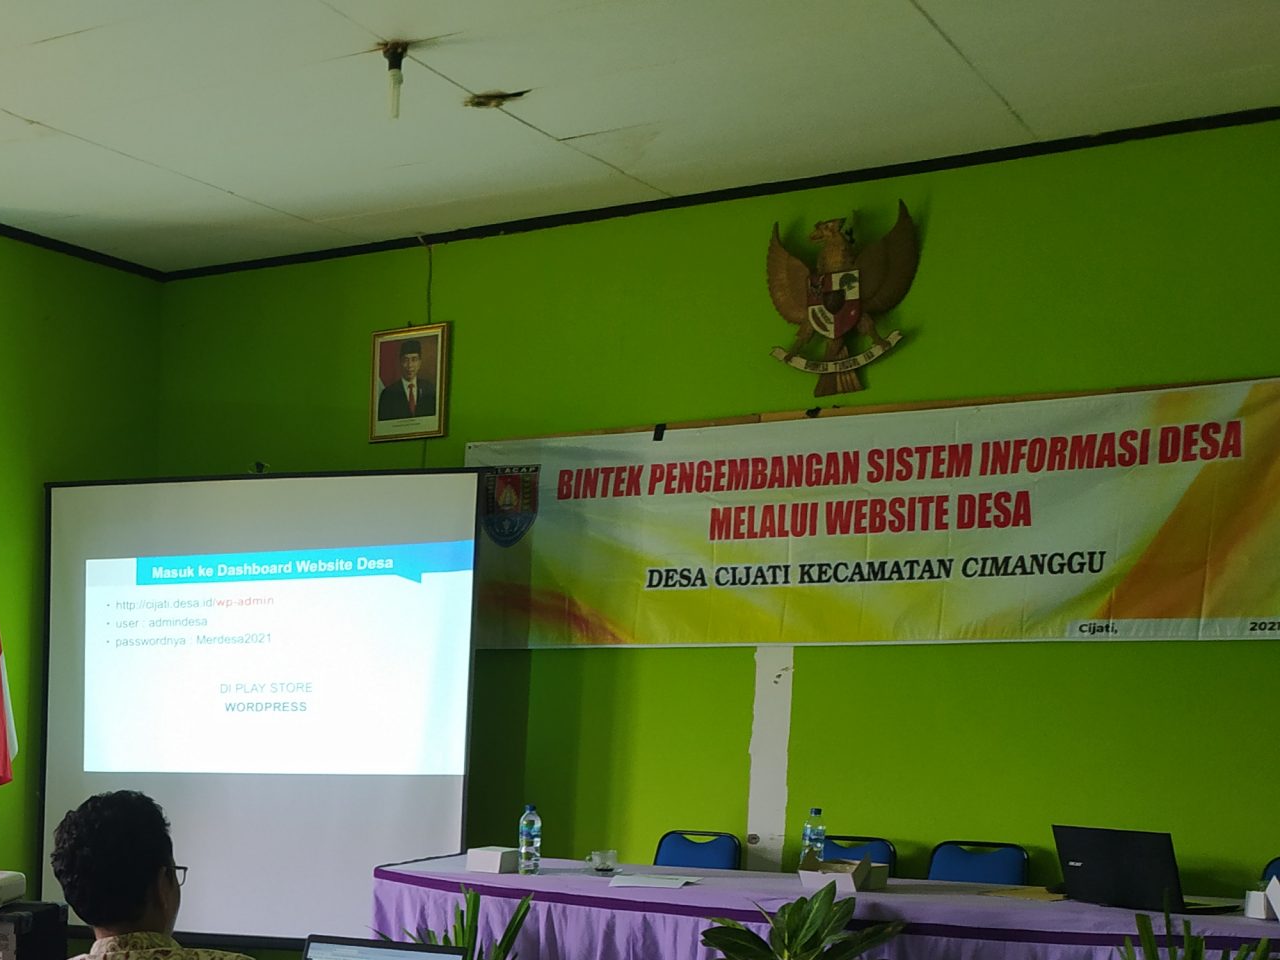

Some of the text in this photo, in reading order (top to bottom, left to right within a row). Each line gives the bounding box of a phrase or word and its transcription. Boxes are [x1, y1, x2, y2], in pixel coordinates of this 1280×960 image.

[556, 420, 1243, 500] BINTEK PENGEMBANGAN SISTEM INFORMASI DESA
[709, 490, 1032, 541] MELALUI WEBSITE DESA
[152, 556, 393, 579] Masuk ke Dashboard Website Desa
[646, 551, 1107, 589] DESA CIJATI KECAMATAN CIMANGGU
[116, 619, 139, 629] user
[149, 617, 208, 628] admindesa
[1078, 623, 1118, 635] Cijati,
[115, 636, 186, 648] passwordnya
[196, 633, 272, 645] Merdesa2021
[220, 682, 312, 694] DI PLAY STORE
[225, 701, 307, 712] WORDPRESS
